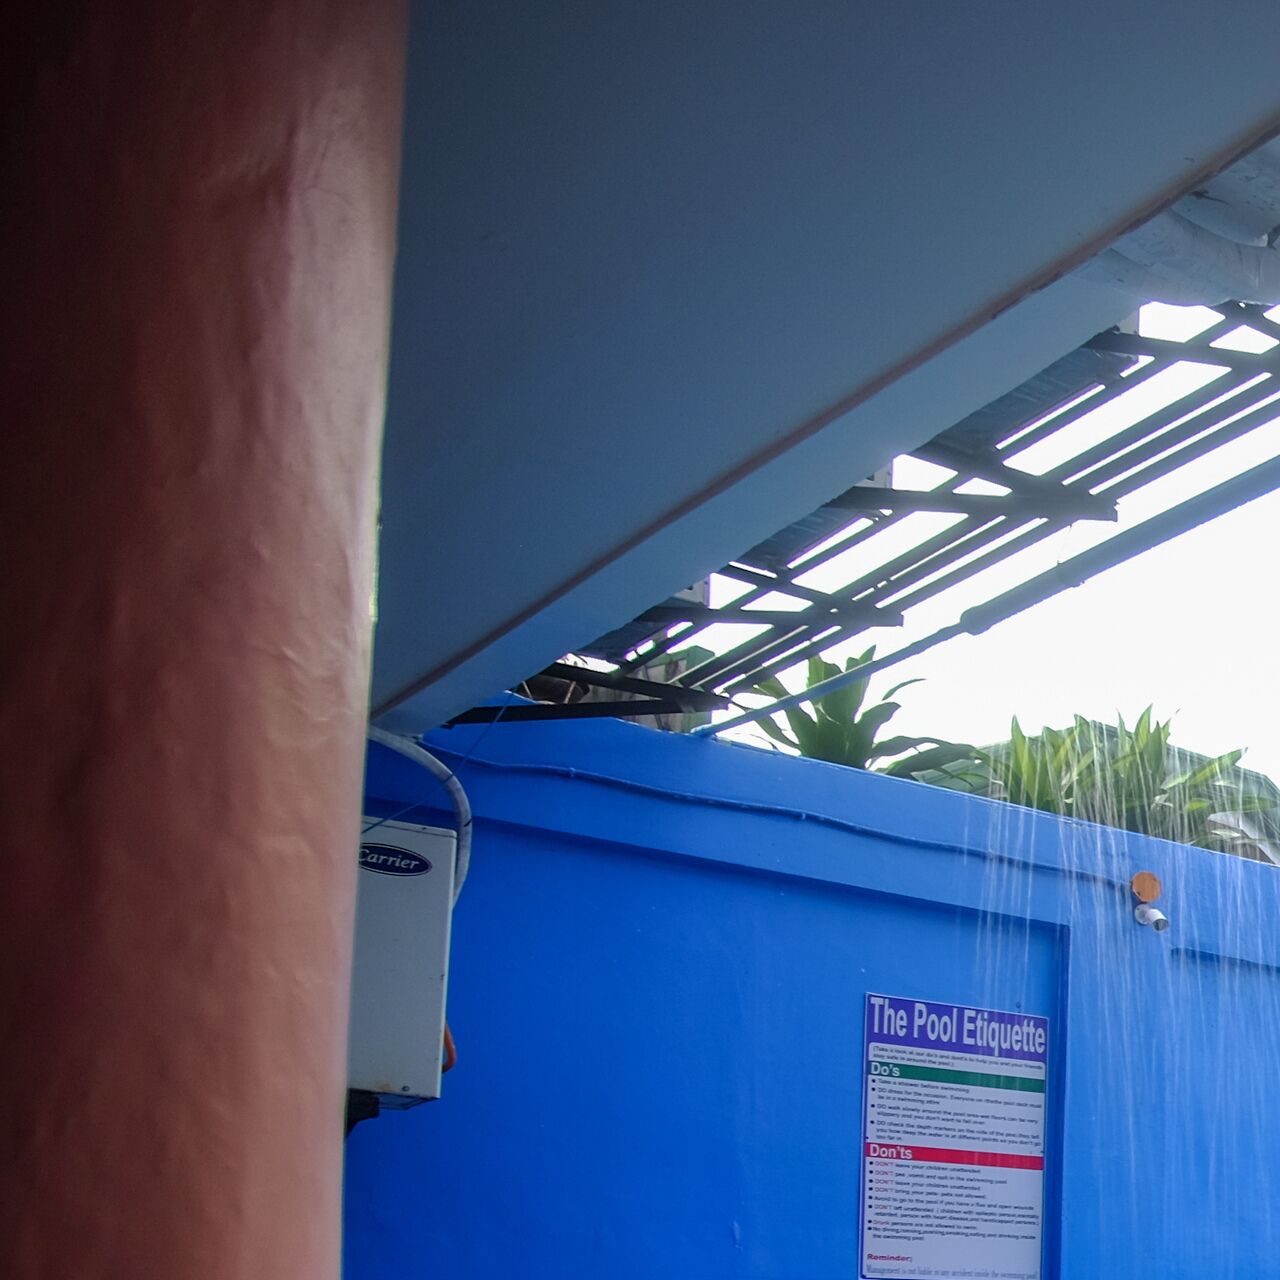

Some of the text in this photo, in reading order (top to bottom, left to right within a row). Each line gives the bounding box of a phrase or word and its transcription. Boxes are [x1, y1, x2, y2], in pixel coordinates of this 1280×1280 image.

[359, 849, 419, 869] Carrier
[870, 997, 1045, 1056] The Pool Etiquette
[870, 1061, 900, 1077] Do's
[868, 1144, 912, 1159] Don'ts
